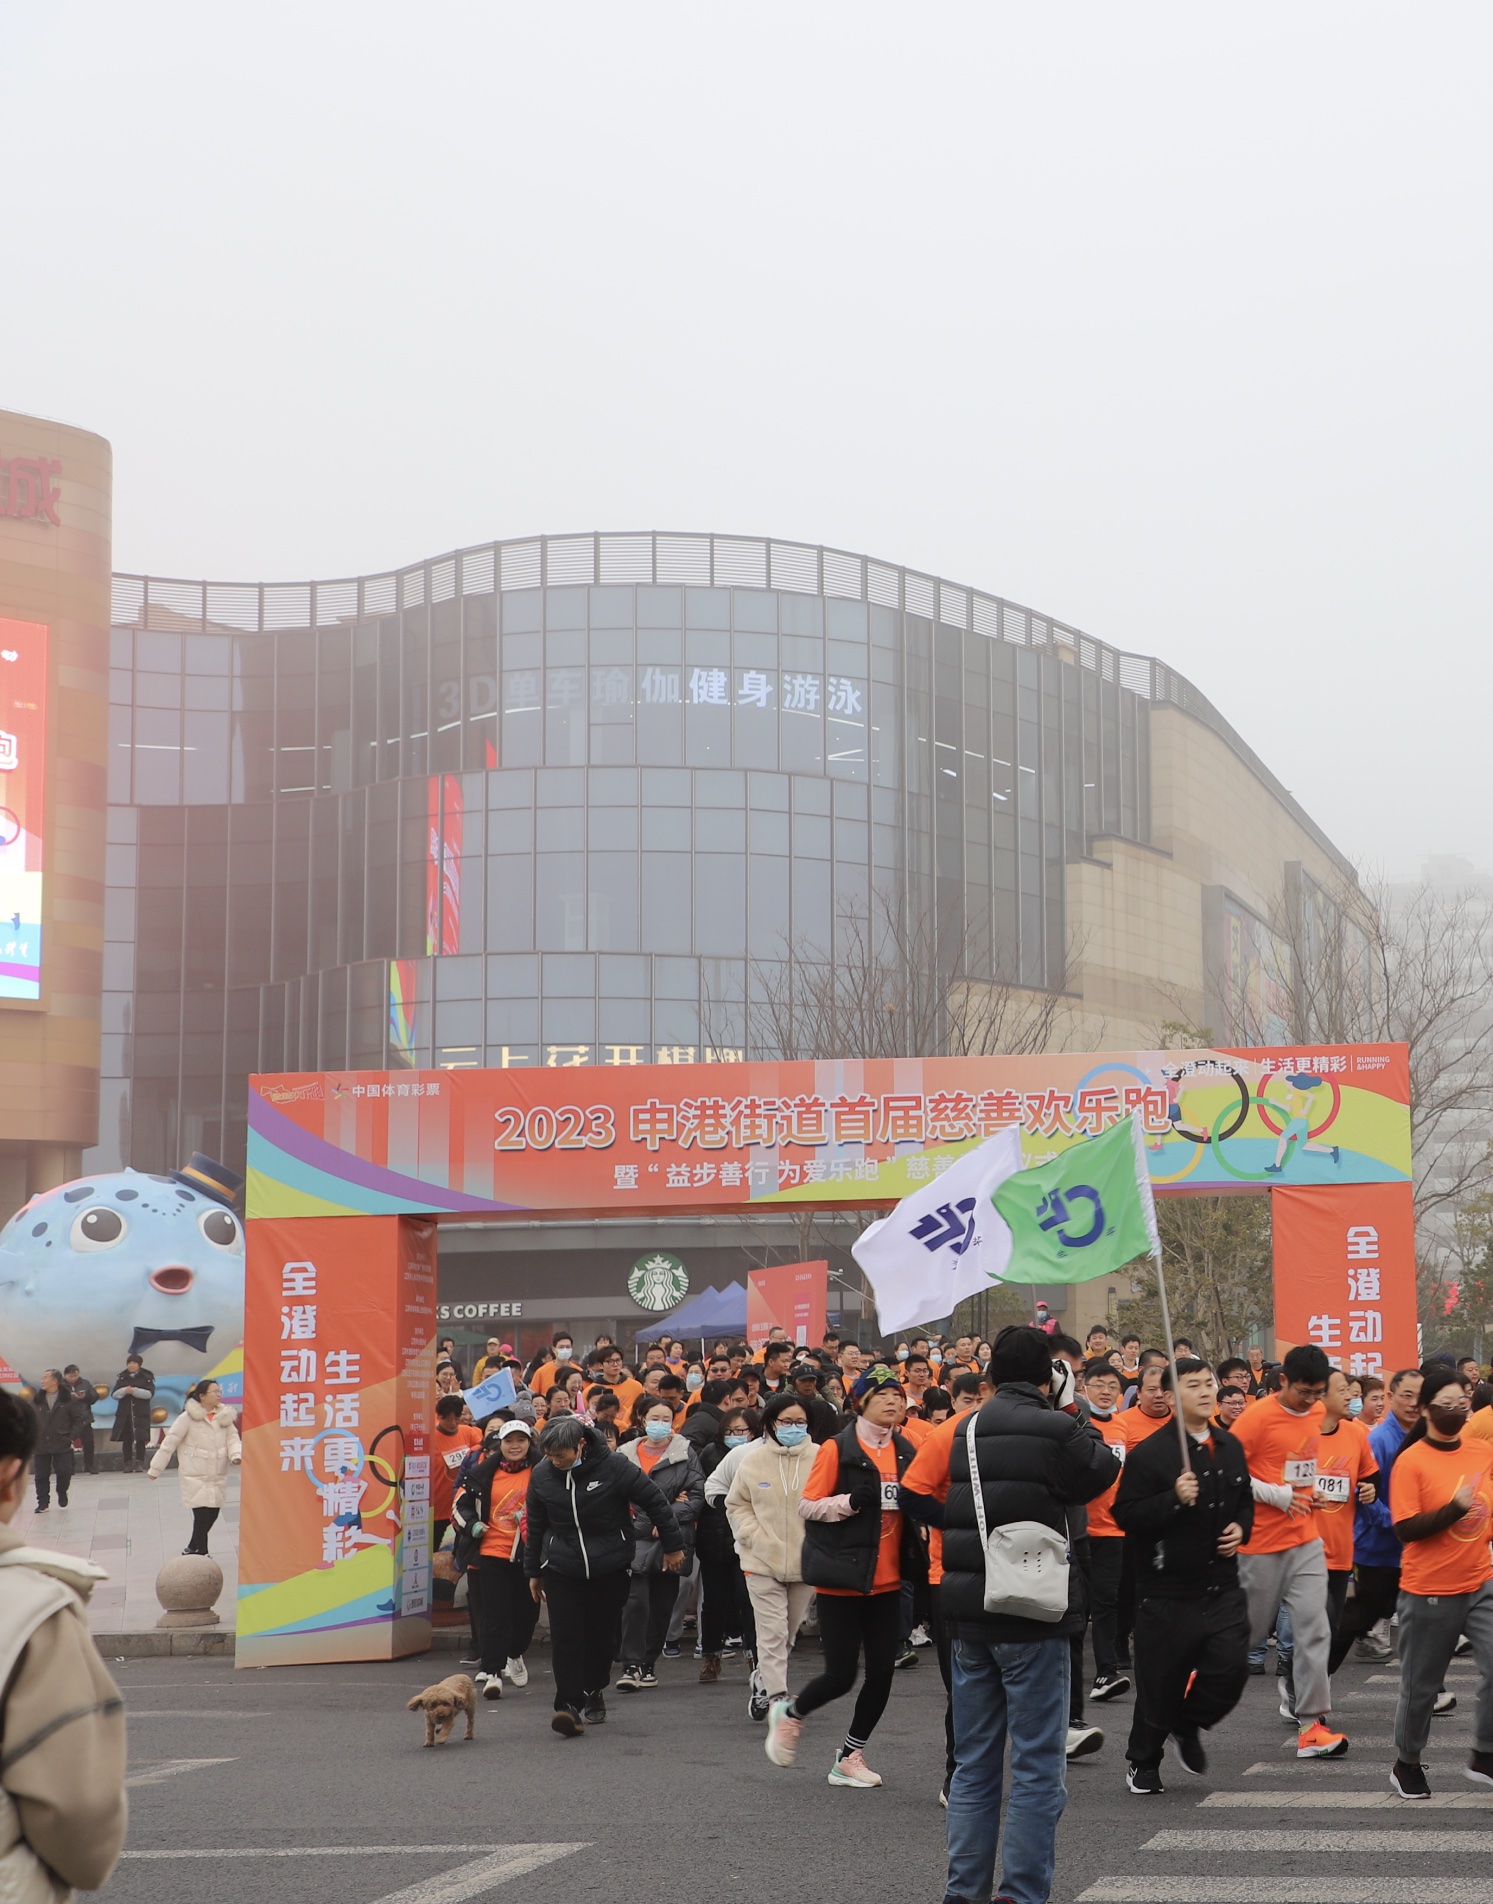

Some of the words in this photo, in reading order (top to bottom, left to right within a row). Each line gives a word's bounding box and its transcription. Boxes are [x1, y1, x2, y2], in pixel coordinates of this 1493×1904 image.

[1163, 1060, 1249, 1079] 全澄动起来
[1261, 1055, 1347, 1075] 生活更精彩
[352, 1083, 440, 1098] 中国体育彩票
[494, 1104, 616, 1151] 2023
[629, 1083, 1173, 1152] 申港街道首届慈善欢乐跑
[453, 1302, 522, 1319] COFFEE
[279, 1260, 318, 1472] 全澄动起来
[322, 1349, 362, 1563] 生活更精彩
[883, 1484, 900, 1500] 60
[1318, 1477, 1343, 1493] 081
